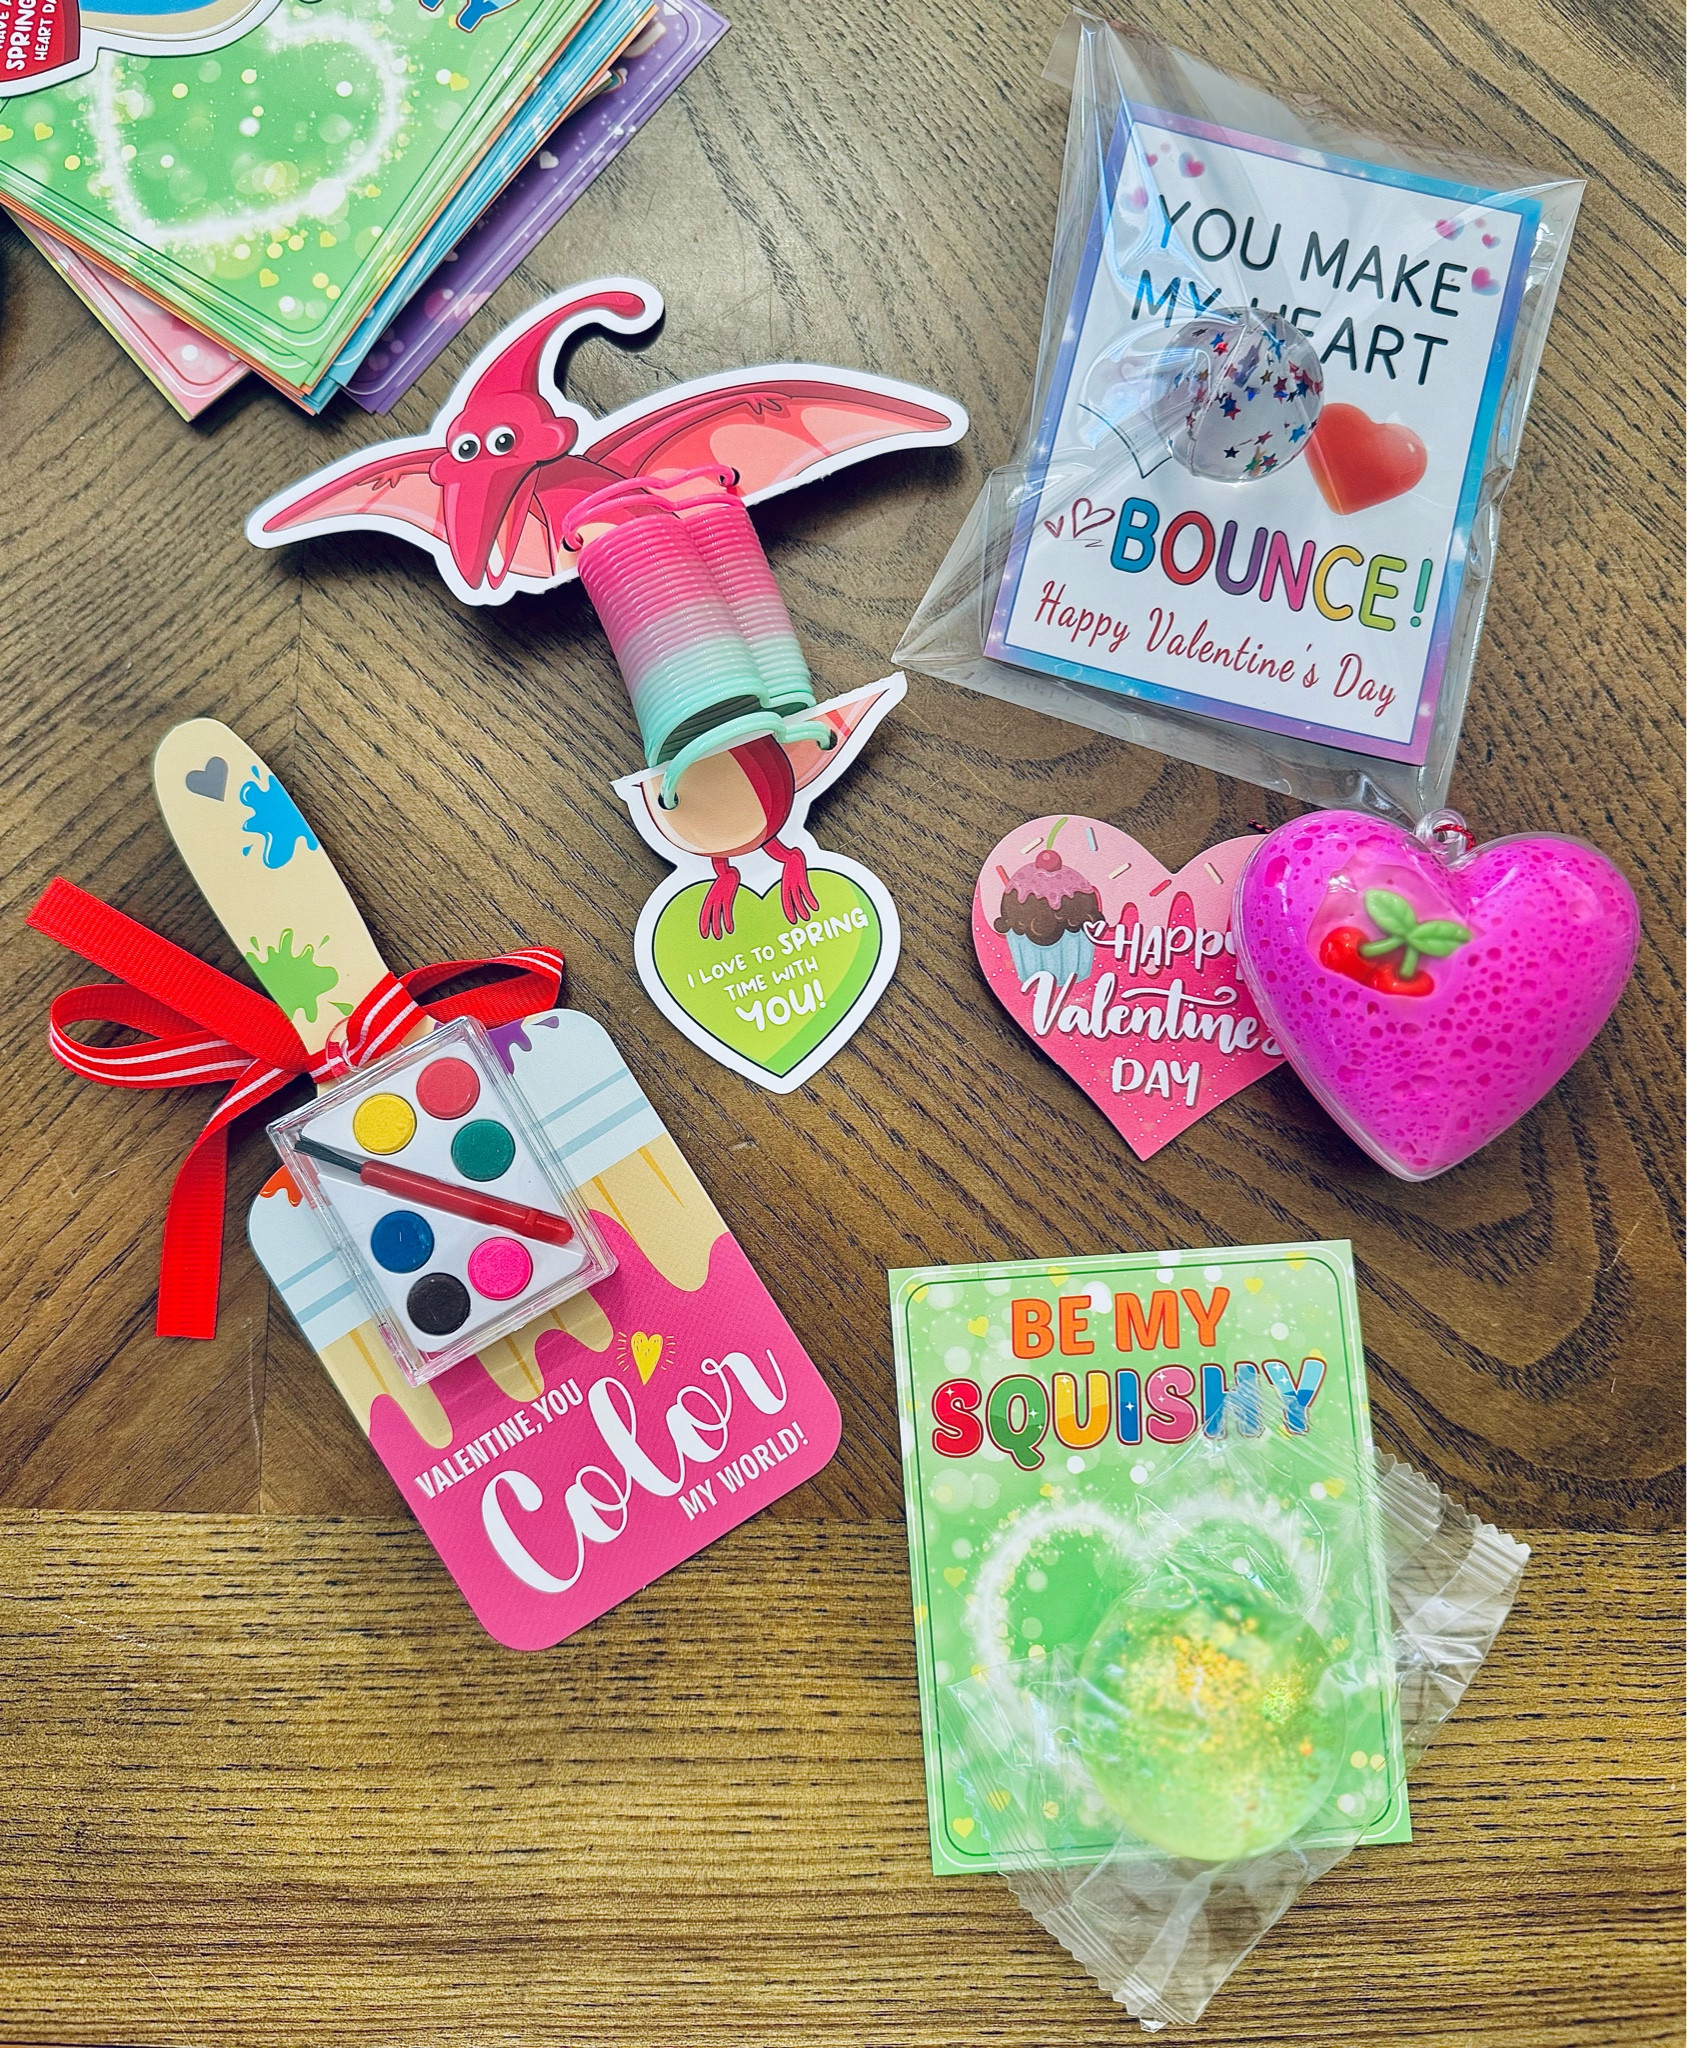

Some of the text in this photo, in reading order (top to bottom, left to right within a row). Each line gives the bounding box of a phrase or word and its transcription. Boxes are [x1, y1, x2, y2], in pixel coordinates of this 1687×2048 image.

[6, 0, 36, 70] SPRING
[34, 18, 53, 60] HEART
[1159, 194, 1469, 318] YOU MAKE
[1131, 270, 1449, 386] MY EART
[1110, 497, 1435, 632] BOUNCE!
[1034, 580, 1398, 718] Happy Valentine's Day
[687, 907, 869, 989] I LOVE TO SPRING
[723, 956, 819, 1001] TIME WITH
[735, 979, 827, 1031] YOU!
[1112, 1057, 1200, 1106] DAY
[1011, 1286, 1231, 1359] BE MY
[413, 1377, 585, 1500] VALENTINE, YOU
[931, 1356, 1327, 1471] SQUISHY
[481, 1349, 788, 1594] Color
[677, 1420, 810, 1522] MY WORLD!
